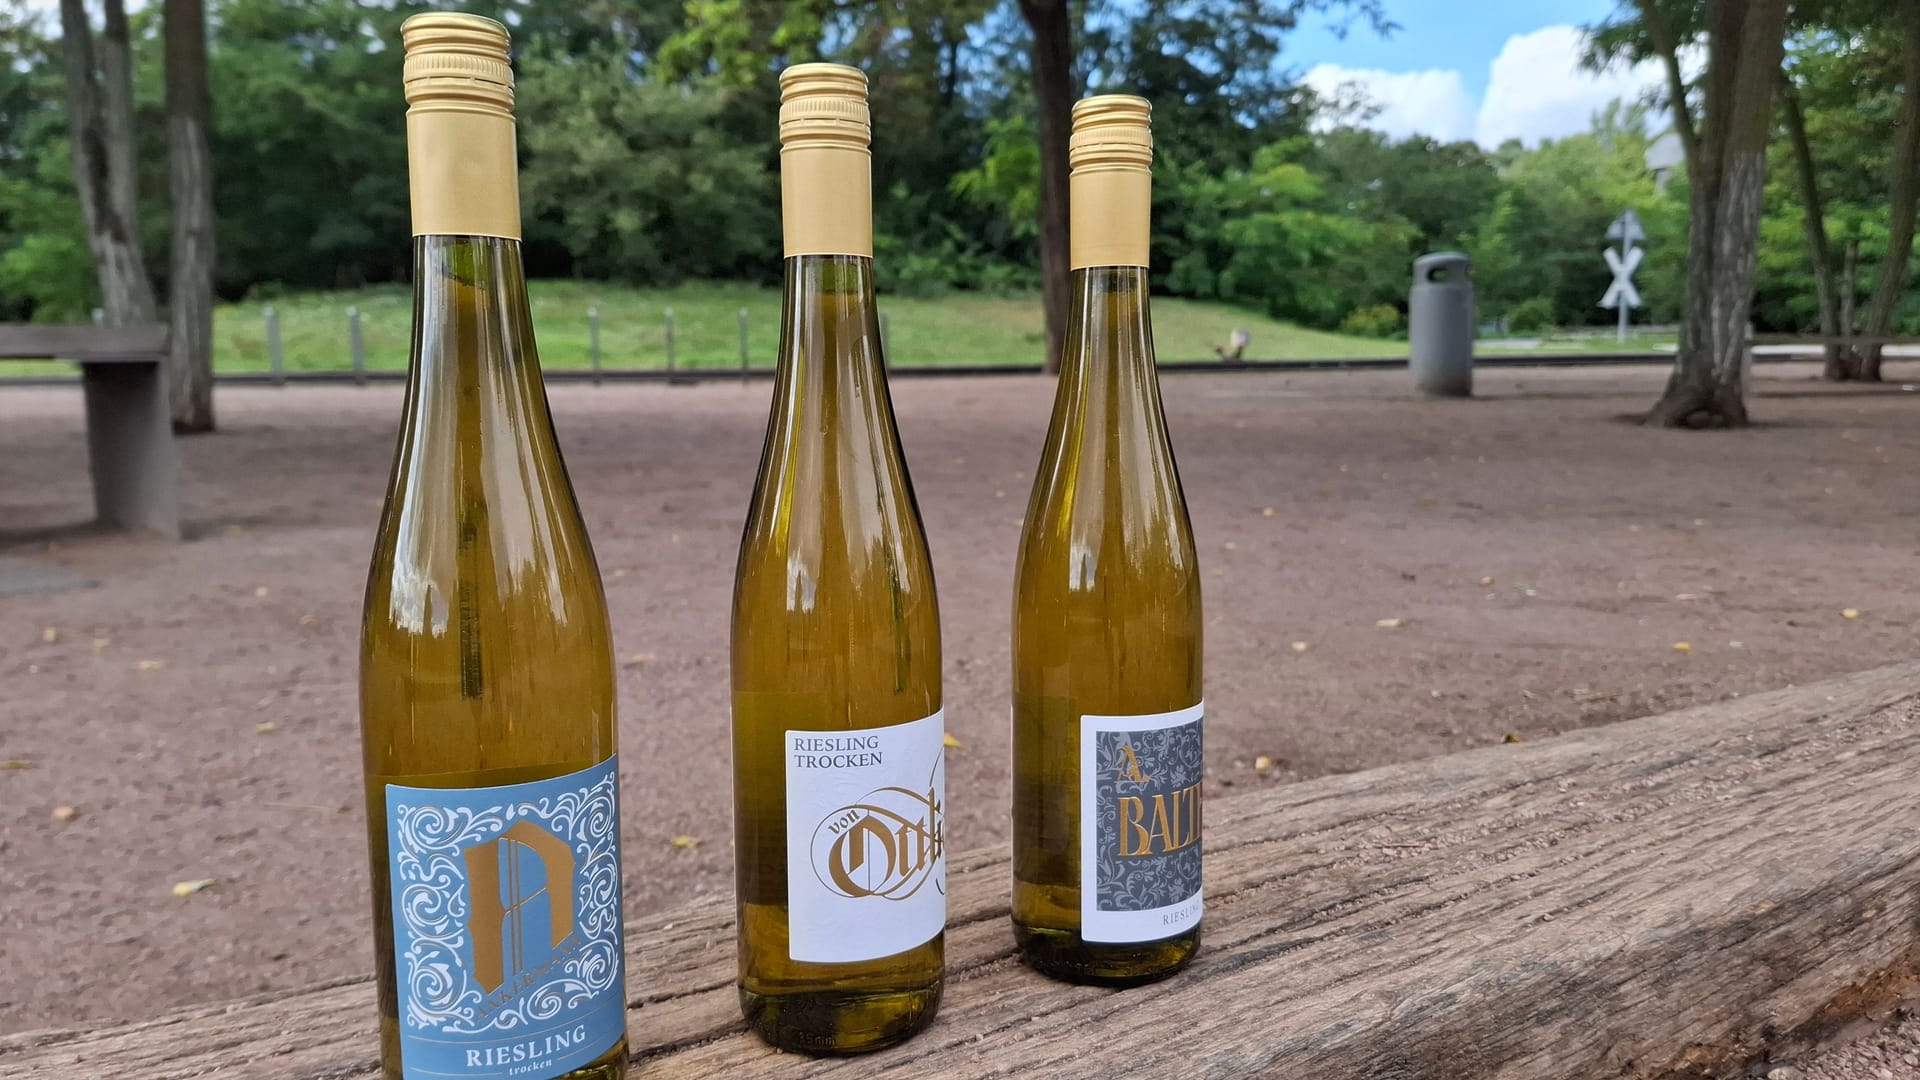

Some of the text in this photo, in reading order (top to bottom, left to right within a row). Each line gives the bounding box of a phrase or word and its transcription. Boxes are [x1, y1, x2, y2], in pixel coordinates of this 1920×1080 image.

[793, 735, 880, 752] RIESLING
[793, 751, 883, 769] TROCKEN
[827, 809, 860, 835] von
[1162, 902, 1201, 926] RIESLIN
[465, 1024, 586, 1068] RIESLING
[508, 1059, 552, 1077] trocken
